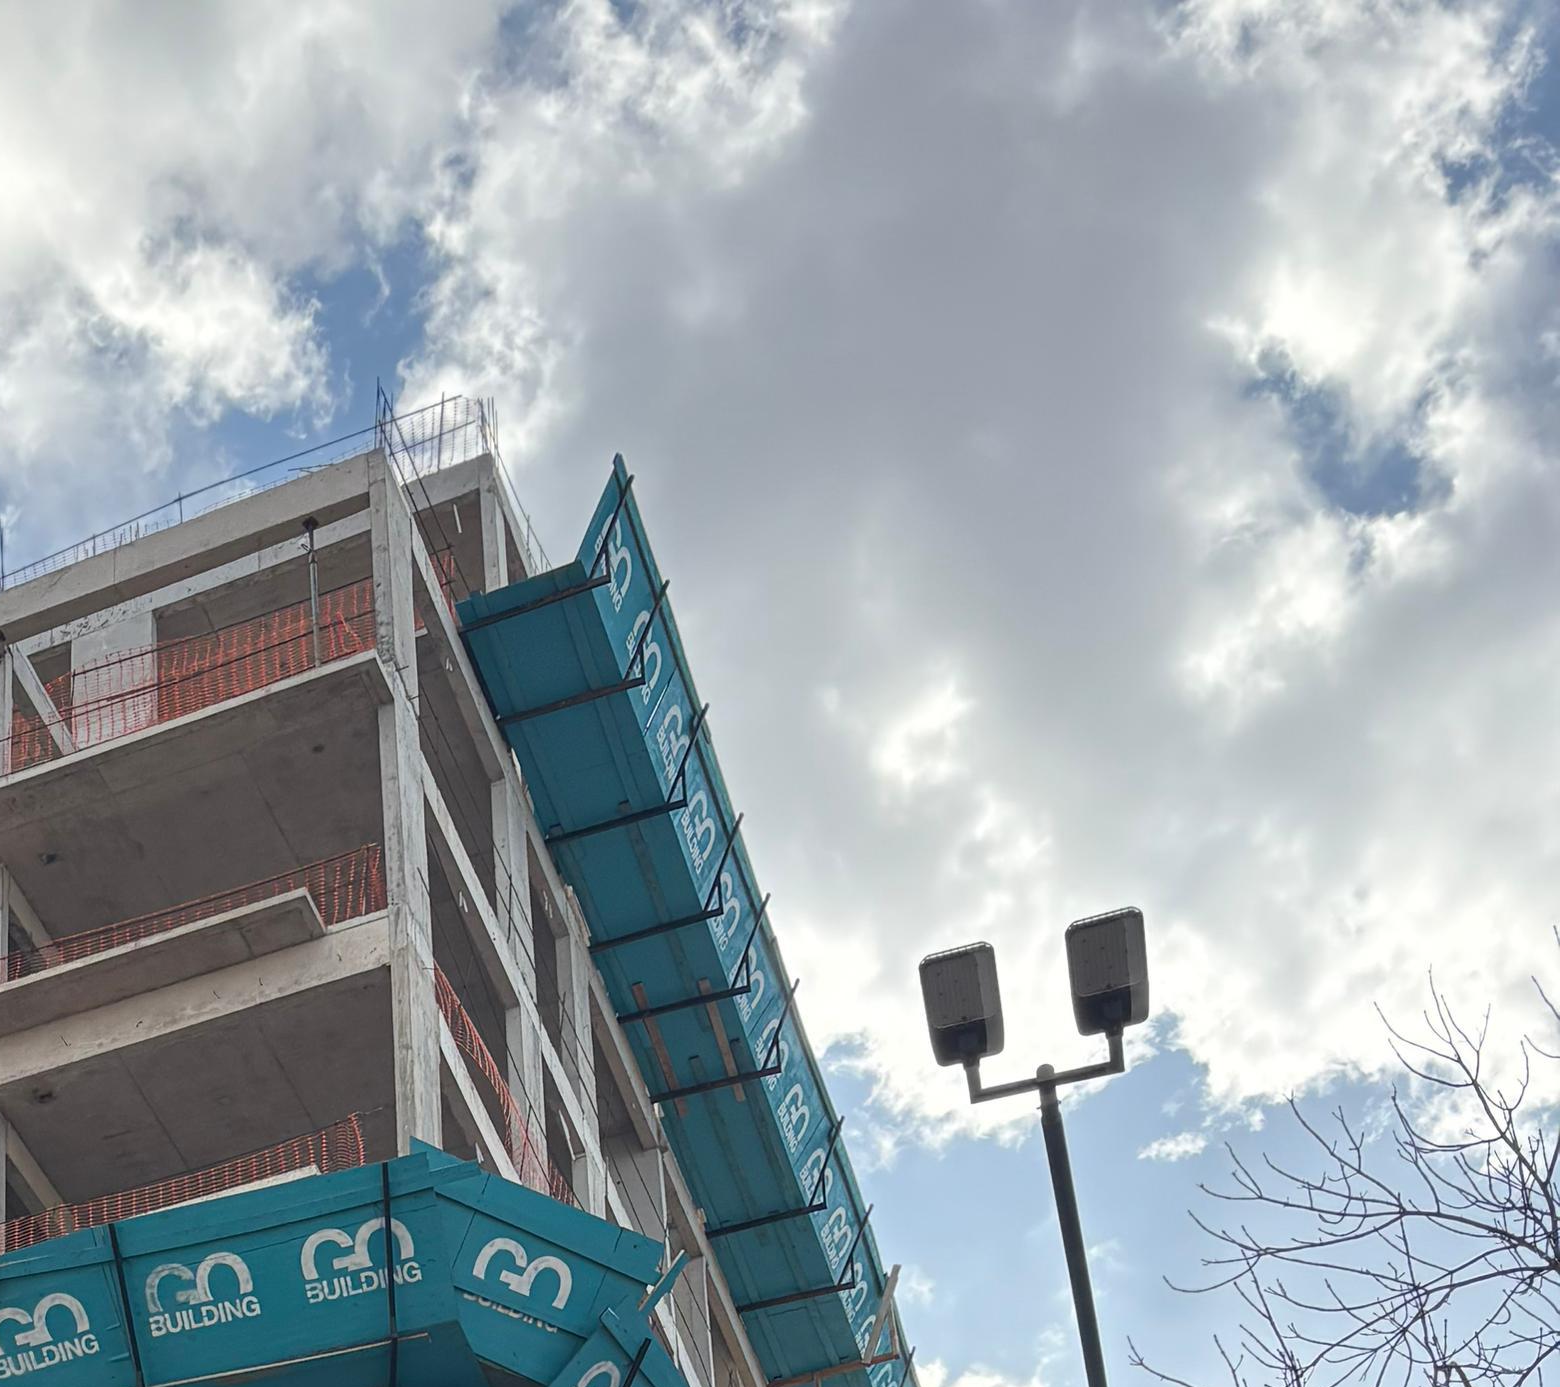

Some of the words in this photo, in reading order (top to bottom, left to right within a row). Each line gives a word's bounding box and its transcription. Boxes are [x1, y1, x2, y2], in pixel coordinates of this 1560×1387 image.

[689, 790, 716, 861] GO
[302, 1217, 415, 1281] GO
[473, 1238, 572, 1310] GO
[145, 1252, 254, 1313] GO
[305, 1261, 422, 1304] BUILDING
[149, 1295, 262, 1338] BUILDING
